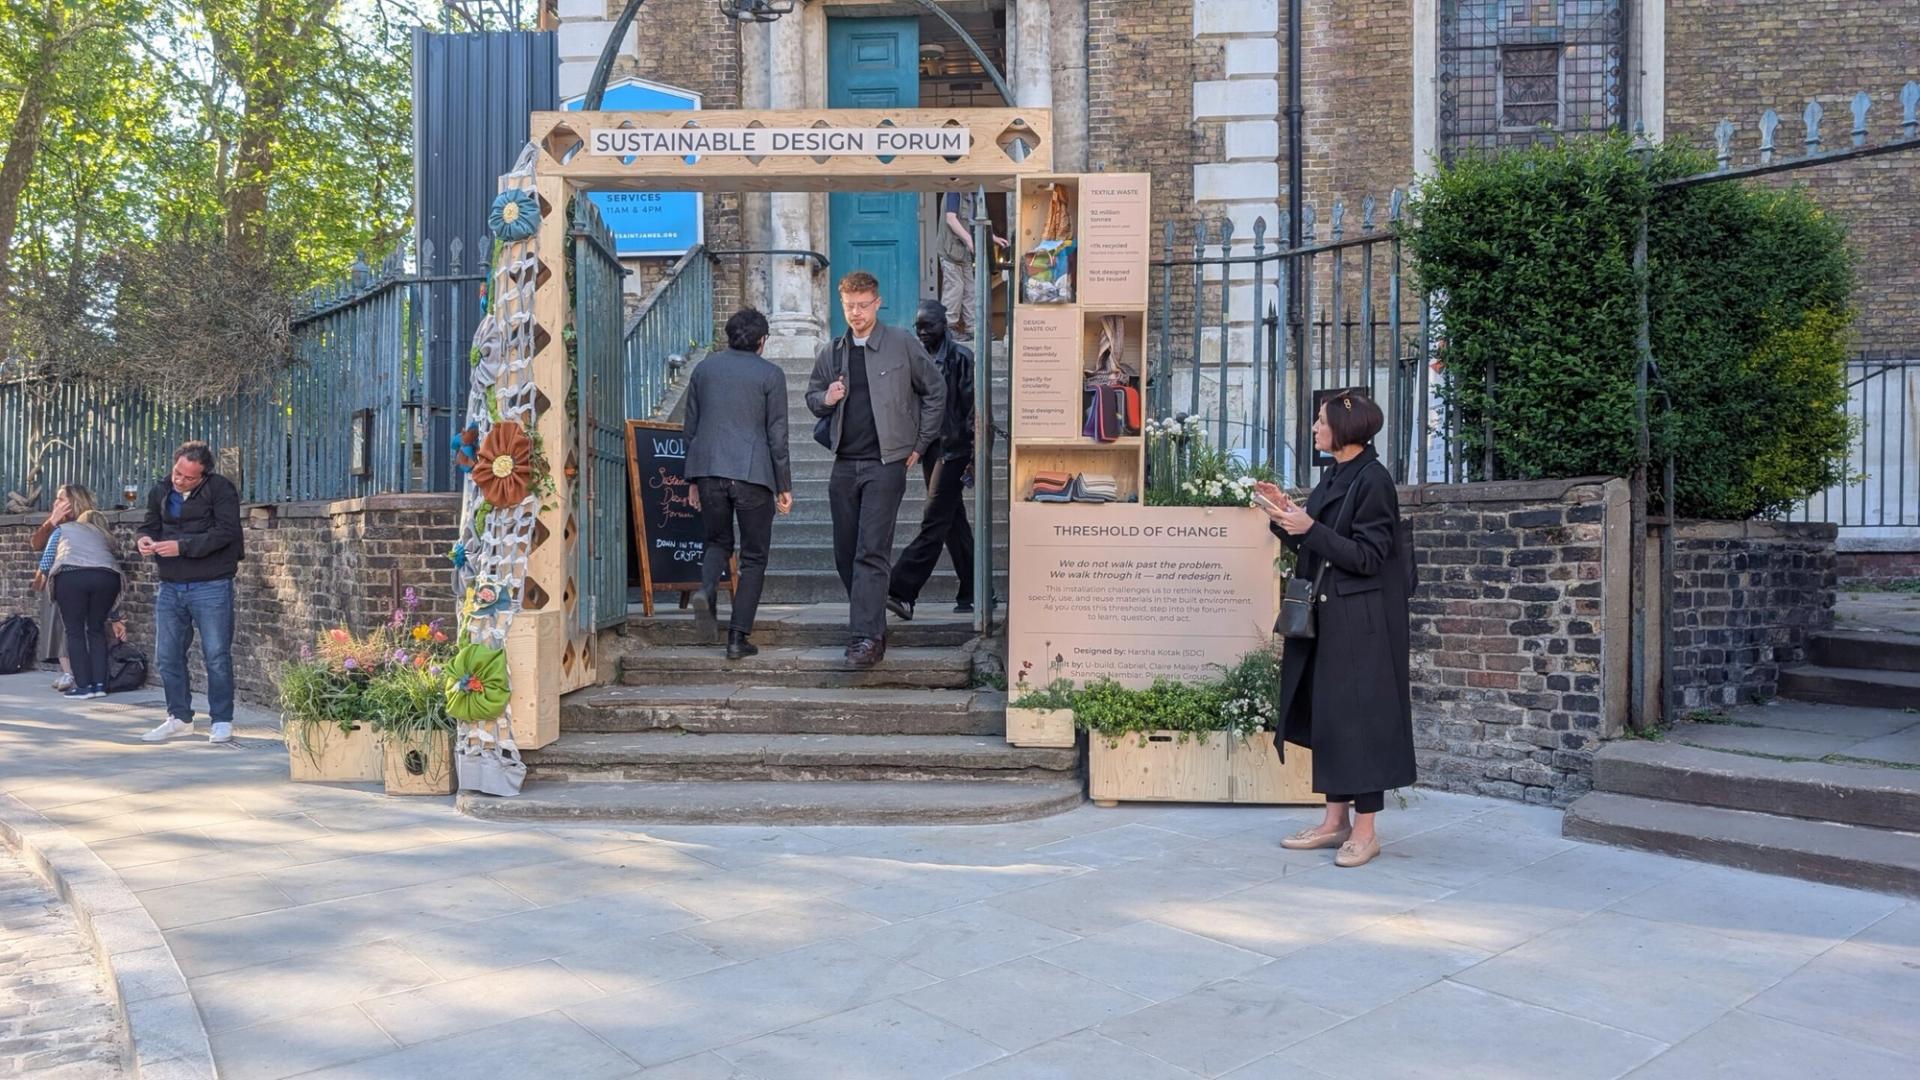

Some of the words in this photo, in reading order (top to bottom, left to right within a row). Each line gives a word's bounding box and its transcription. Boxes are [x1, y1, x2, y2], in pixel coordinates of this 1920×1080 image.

[596, 132, 756, 152] SUSTAINABLE
[772, 132, 863, 152] DESIGN
[877, 132, 962, 151] FORUM
[607, 193, 661, 202] SERVICES
[632, 206, 638, 214] &
[1102, 242, 1128, 250] recycled
[1053, 525, 1140, 537] THRESHOLD
[1143, 526, 1163, 537] OF
[1167, 526, 1228, 537] CHANGE
[655, 538, 676, 548] DOWN
[673, 550, 704, 561] CRYPT
[1060, 560, 1075, 568] We
[1077, 560, 1090, 568] do
[1111, 560, 1134, 568] walk
[1135, 561, 1157, 569] past
[1160, 561, 1176, 569] the
[1178, 561, 1223, 570] problem.
[1050, 570, 1066, 578] We
[1068, 570, 1090, 579] walk
[1093, 570, 1132, 581] through
[1134, 571, 1142, 579] it
[1155, 572, 1176, 580] and
[1177, 572, 1221, 582] redesign
[1223, 572, 1233, 581] it.
[1107, 586, 1150, 594] challenges
[1028, 594, 1056, 602] specify,
[1199, 597, 1252, 605] environment.
[1109, 604, 1147, 612] threshold,
[1098, 613, 1119, 621] learn,
[1120, 614, 1158, 622] question,
[1073, 647, 1112, 656] Designed
[1114, 647, 1126, 656] by:
[1183, 649, 1205, 657] (SDC)
[1051, 660, 1069, 668] Bilt
[1071, 661, 1083, 669] by:
[1118, 662, 1147, 670] Gabriel,
[1149, 662, 1172, 670] Claire
[1183, 672, 1208, 680] Group
